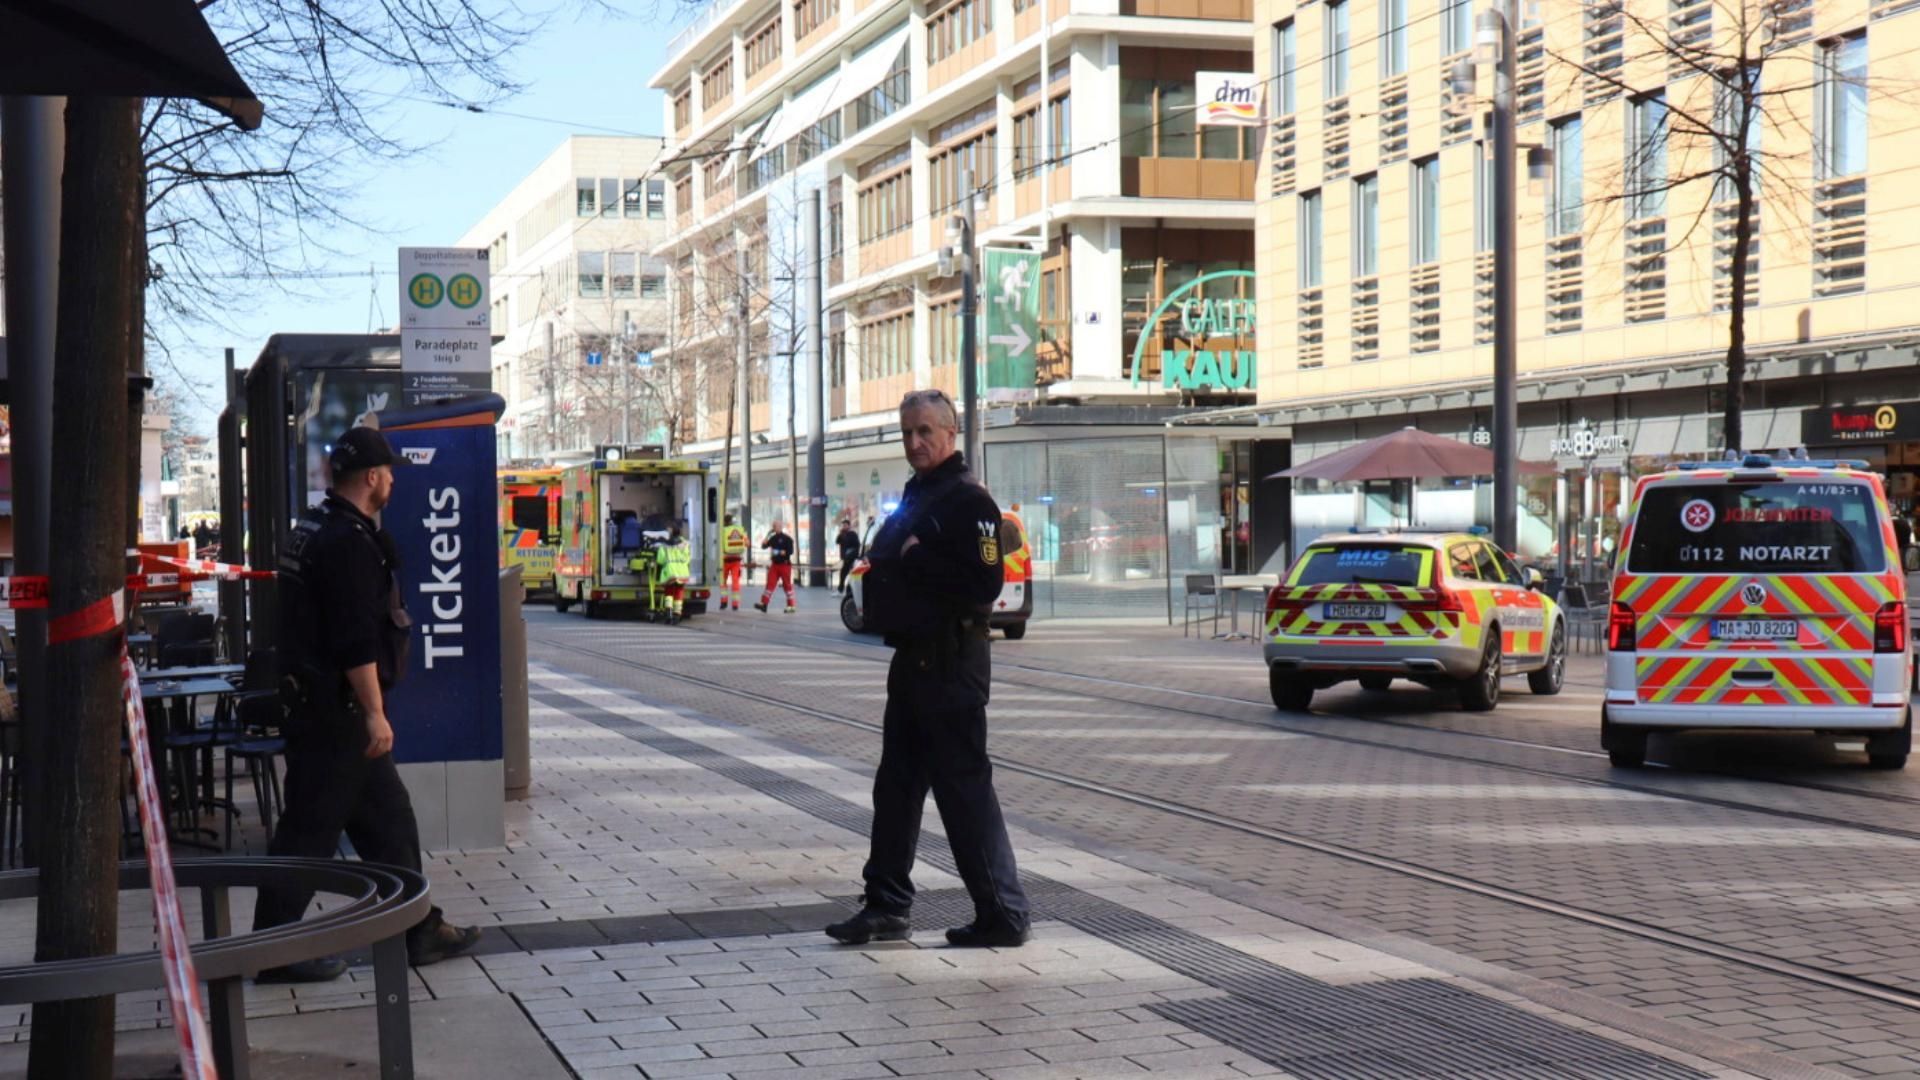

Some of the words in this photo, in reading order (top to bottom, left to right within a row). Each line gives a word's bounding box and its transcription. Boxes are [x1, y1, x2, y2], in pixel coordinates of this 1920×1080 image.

[1215, 80, 1251, 102] dm
[419, 281, 435, 300] H
[456, 282, 472, 300] H
[414, 338, 479, 352] Paradeplatz
[434, 354, 454, 364] Steig
[455, 354, 461, 362] D
[1161, 350, 1256, 389] KAU
[412, 376, 419, 387] 2
[414, 394, 420, 405] 3
[1797, 486, 1806, 495] A
[1723, 508, 1833, 522] JOHANNITER
[1692, 548, 1724, 561] 112
[1740, 546, 1832, 561] NOTARZT
[419, 486, 464, 669] Tickets
[1719, 622, 1734, 634] MA
[1745, 622, 1760, 635] JO
[1764, 622, 1795, 635] 8201
